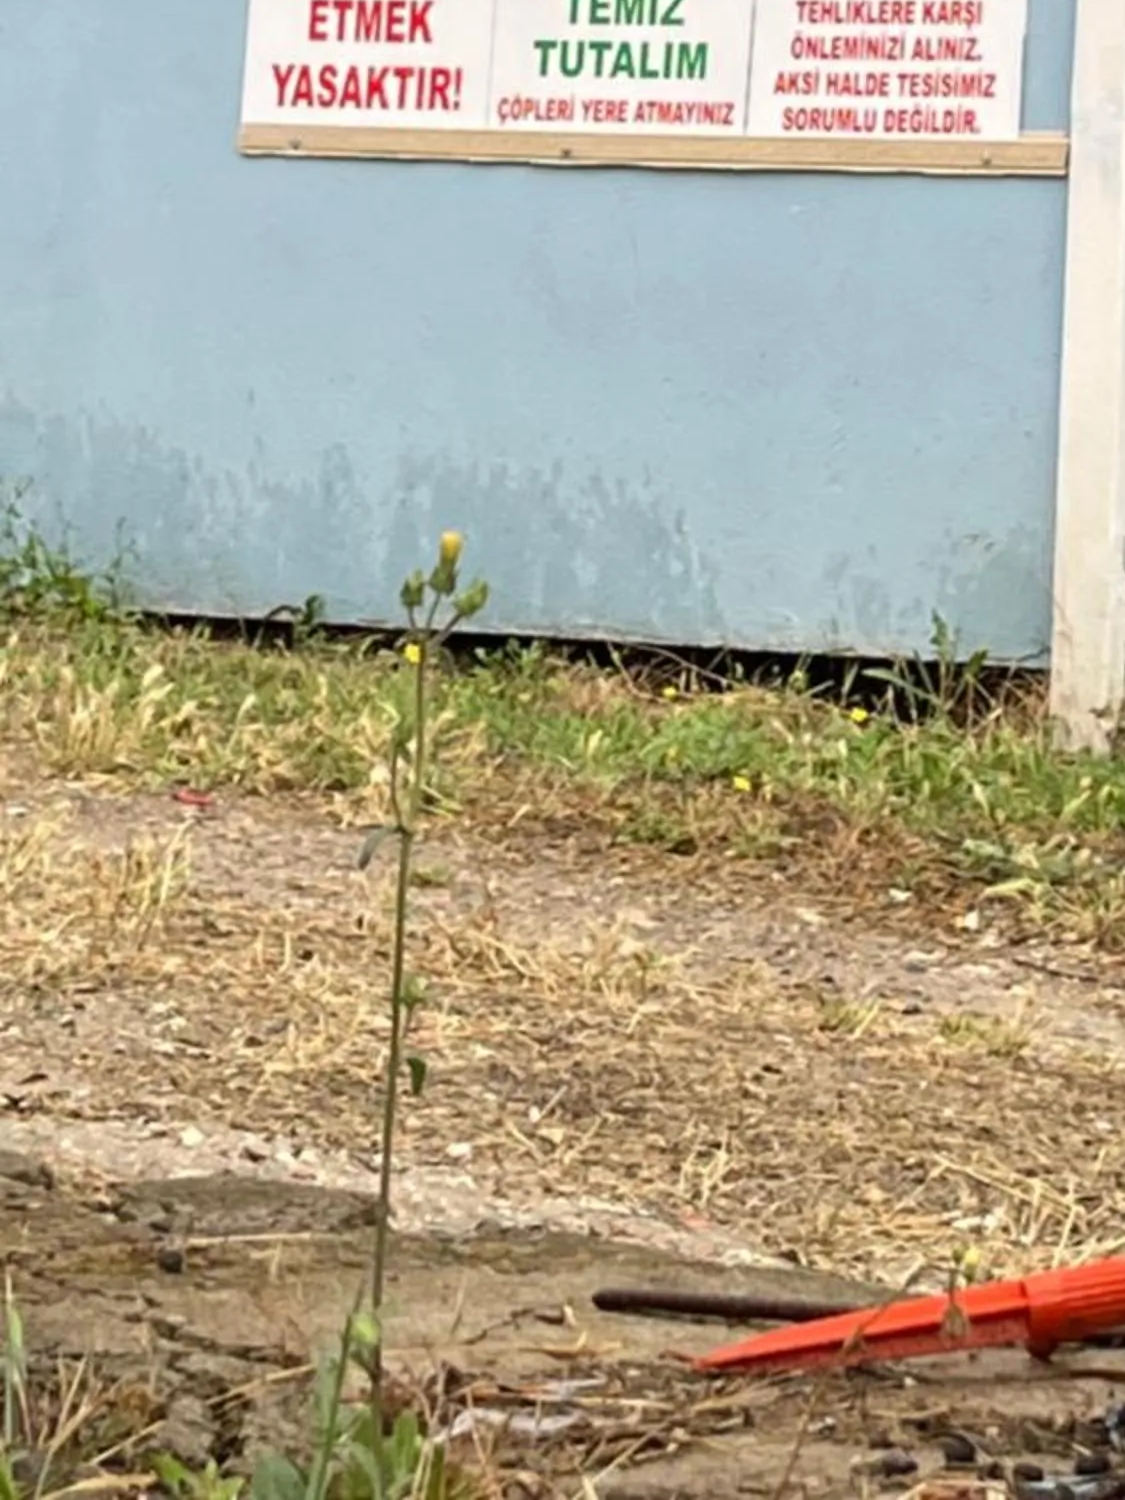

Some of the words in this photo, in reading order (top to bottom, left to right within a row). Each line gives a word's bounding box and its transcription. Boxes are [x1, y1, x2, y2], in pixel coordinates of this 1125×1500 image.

[922, 0, 983, 31] KARŞI
[534, 40, 709, 80] TUTALIM
[790, 30, 906, 60] ÖNLEMİNİZİ
[911, 36, 983, 62] ALINIZ.
[271, 64, 463, 111] YASAKTIR!
[773, 68, 819, 96] AKSİ
[826, 74, 890, 97] HALDE
[898, 70, 997, 99] TESİSİMİZ
[497, 94, 575, 125] ÇÖPLERİ
[582, 99, 628, 123] YERE
[634, 101, 735, 127] ATMAYINIZ
[782, 106, 877, 133] SORUMLU
[884, 104, 982, 135] DEĞİLDİR.
